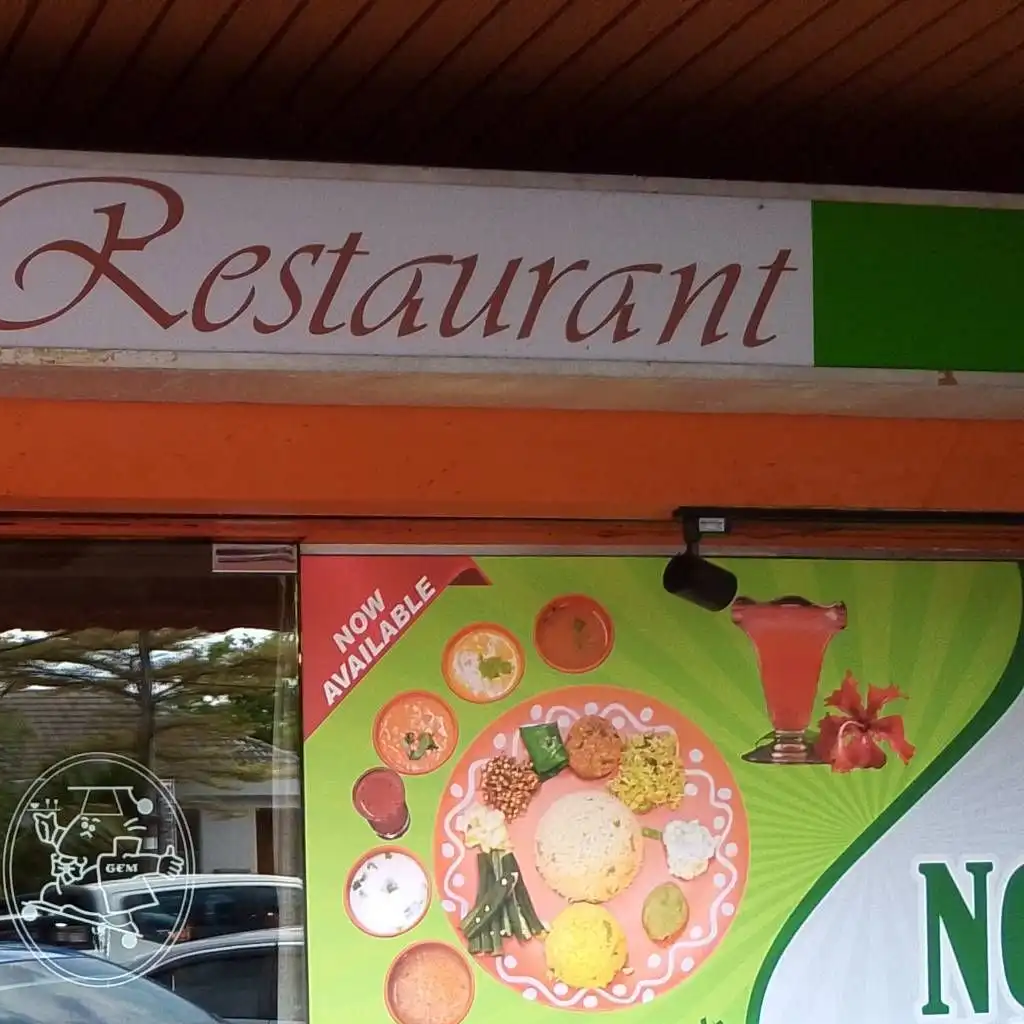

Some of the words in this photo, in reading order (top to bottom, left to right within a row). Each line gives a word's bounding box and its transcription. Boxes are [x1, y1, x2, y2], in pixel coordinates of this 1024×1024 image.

[322, 575, 436, 706] AVAILABLE
[332, 588, 386, 654] NOW
[105, 863, 138, 873] GEM
